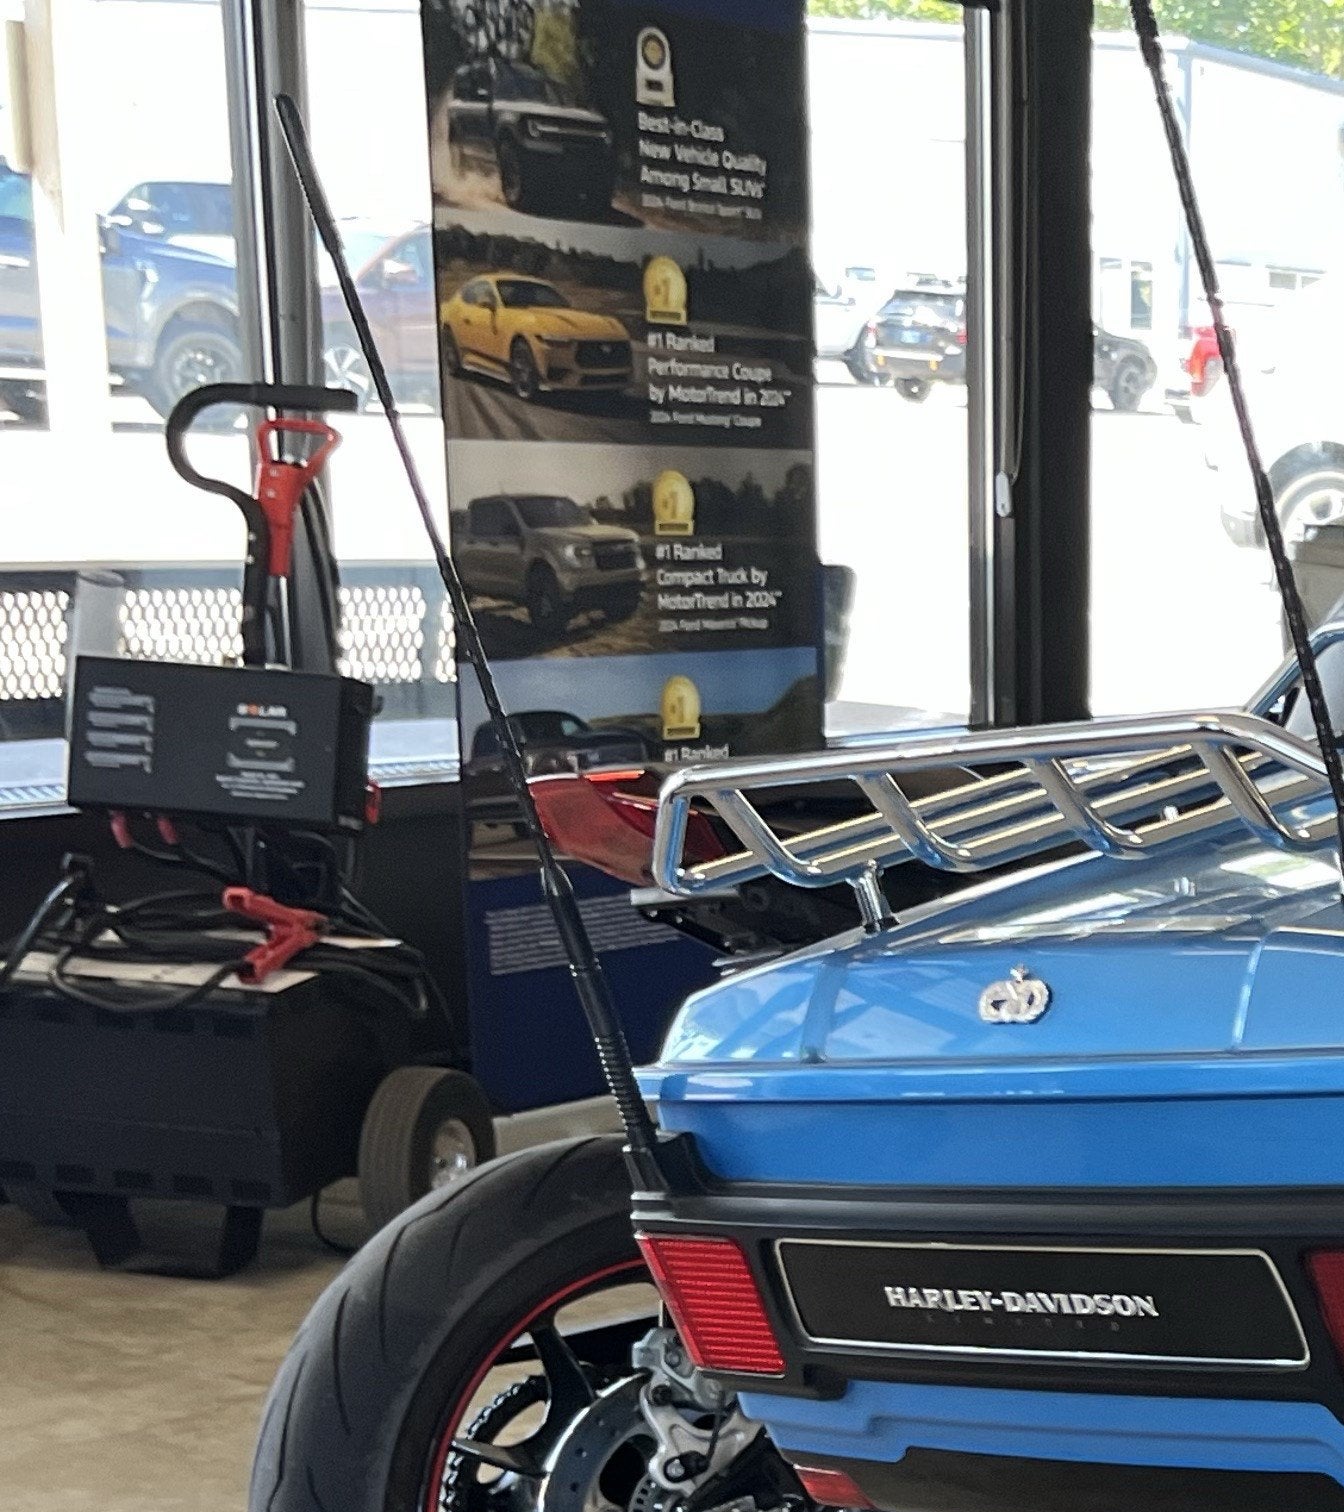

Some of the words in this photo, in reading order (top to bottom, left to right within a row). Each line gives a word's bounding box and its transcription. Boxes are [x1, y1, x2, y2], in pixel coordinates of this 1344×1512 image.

[656, 568, 713, 588] Compact
[750, 567, 768, 587] by
[657, 591, 729, 610] MotorTrend
[731, 592, 743, 608] in
[884, 1286, 1160, 1317] HARLEY-DAVIDSON
